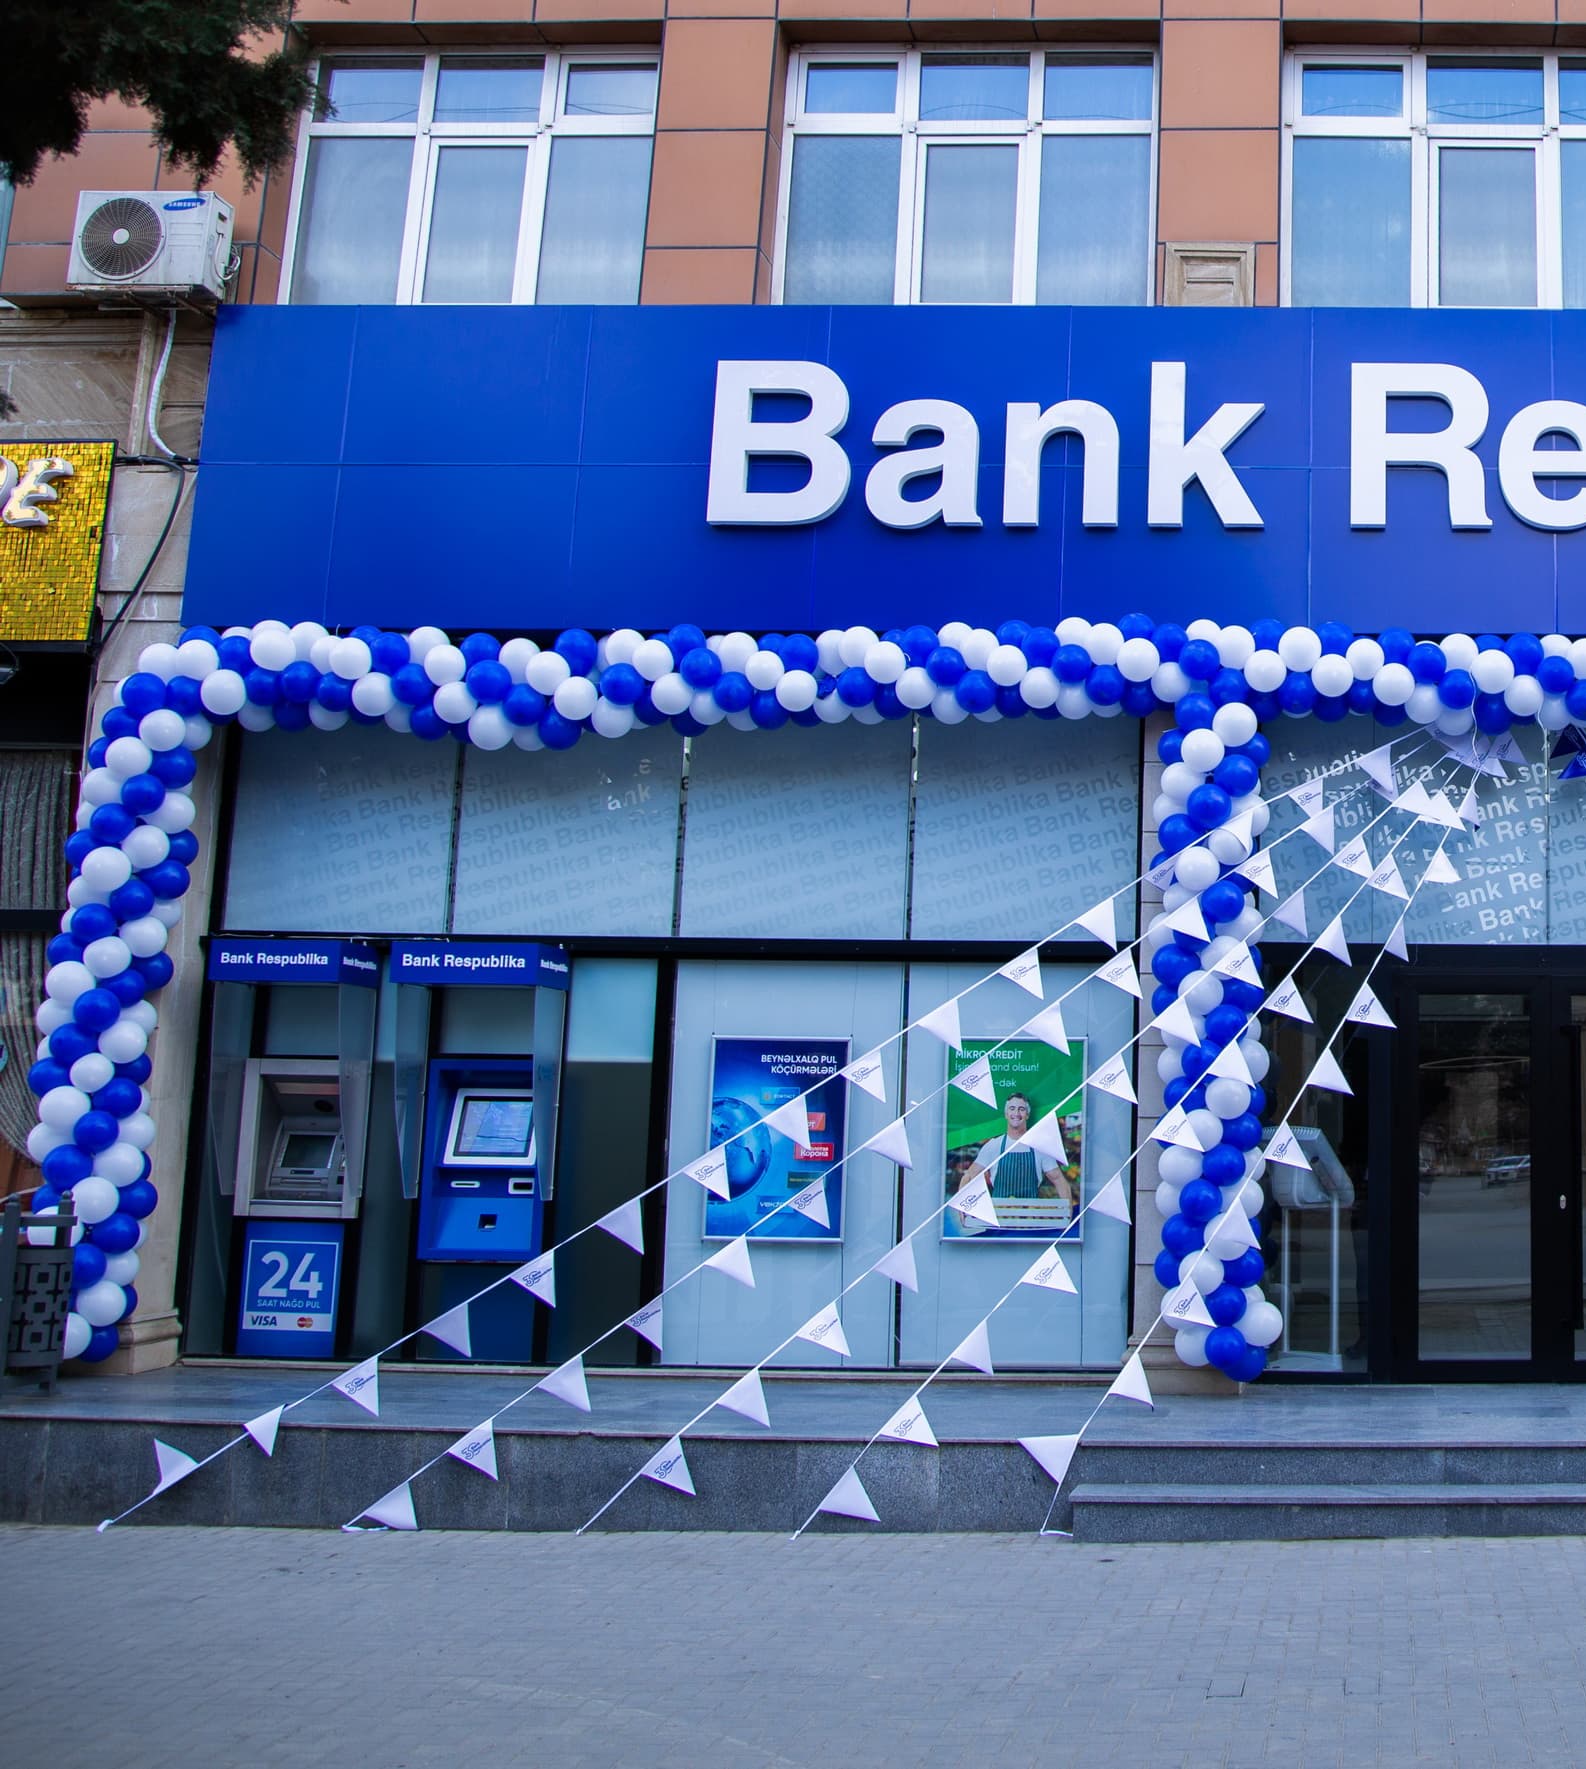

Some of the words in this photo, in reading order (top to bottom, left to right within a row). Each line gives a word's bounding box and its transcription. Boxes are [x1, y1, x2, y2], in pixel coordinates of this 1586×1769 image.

[705, 358, 1265, 527] Bank
[357, 788, 423, 820] Bank
[689, 796, 816, 843] espublika
[917, 790, 1051, 838] espublika
[1055, 769, 1124, 803] Bank
[554, 815, 622, 849] Bank
[788, 810, 857, 843] Bank
[1023, 804, 1092, 837] Bank
[325, 822, 392, 854] Bank
[1067, 821, 1136, 855] Bank
[366, 840, 432, 872] Bank
[1037, 854, 1105, 889] Bank
[1479, 897, 1545, 933] Bank
[220, 952, 254, 965] Bank
[256, 952, 329, 967] Respublika
[402, 953, 440, 967] Bank
[444, 954, 526, 971] Respublika
[761, 1054, 819, 1064] BEYNƏLXALQ
[820, 1055, 838, 1064] PUL
[989, 1048, 1023, 1060] KREDİT
[991, 1062, 1010, 1072] and
[1011, 1062, 1040, 1072] olsun!
[258, 1250, 324, 1299] 24
[257, 1299, 277, 1307] SAAT
[305, 1301, 321, 1309] PUL
[250, 1315, 278, 1326] VISA
